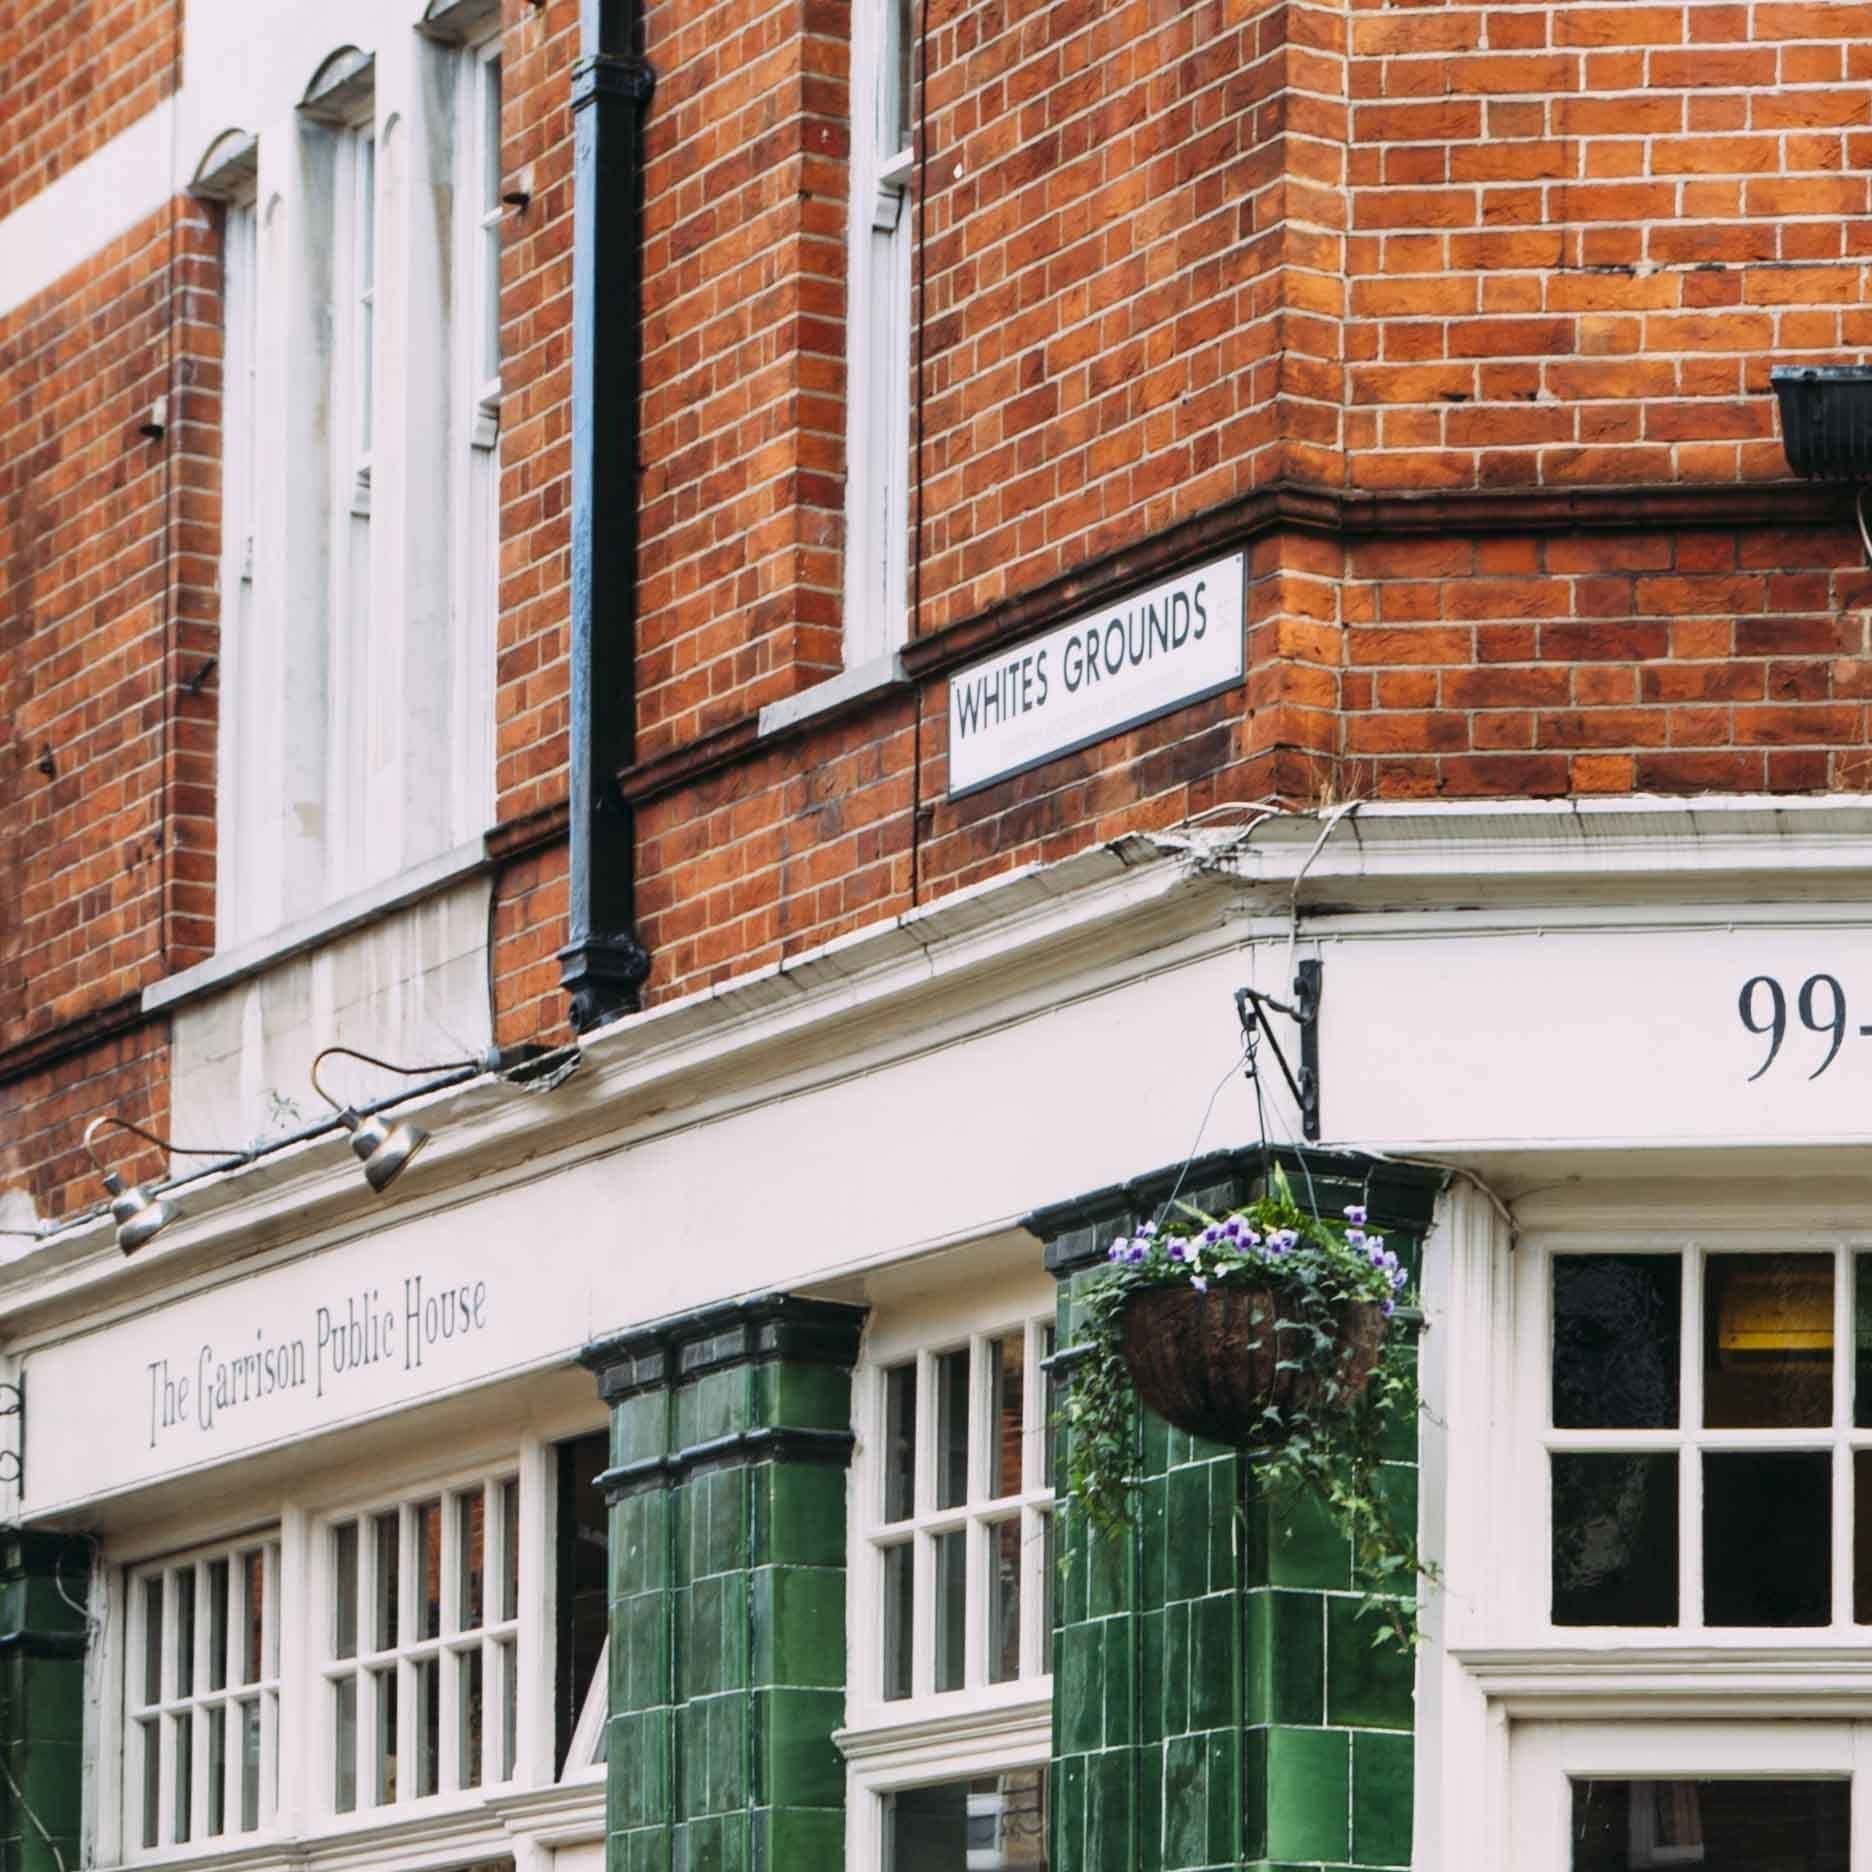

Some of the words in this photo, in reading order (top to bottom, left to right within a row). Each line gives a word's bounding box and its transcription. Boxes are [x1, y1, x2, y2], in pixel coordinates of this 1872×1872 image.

[956, 649, 1048, 740] WHITES
[1062, 581, 1207, 693] GROUNDS
[146, 1360, 190, 1449] The
[197, 1329, 306, 1431] Garrison
[315, 1290, 395, 1399] Public
[404, 1275, 487, 1372] House
